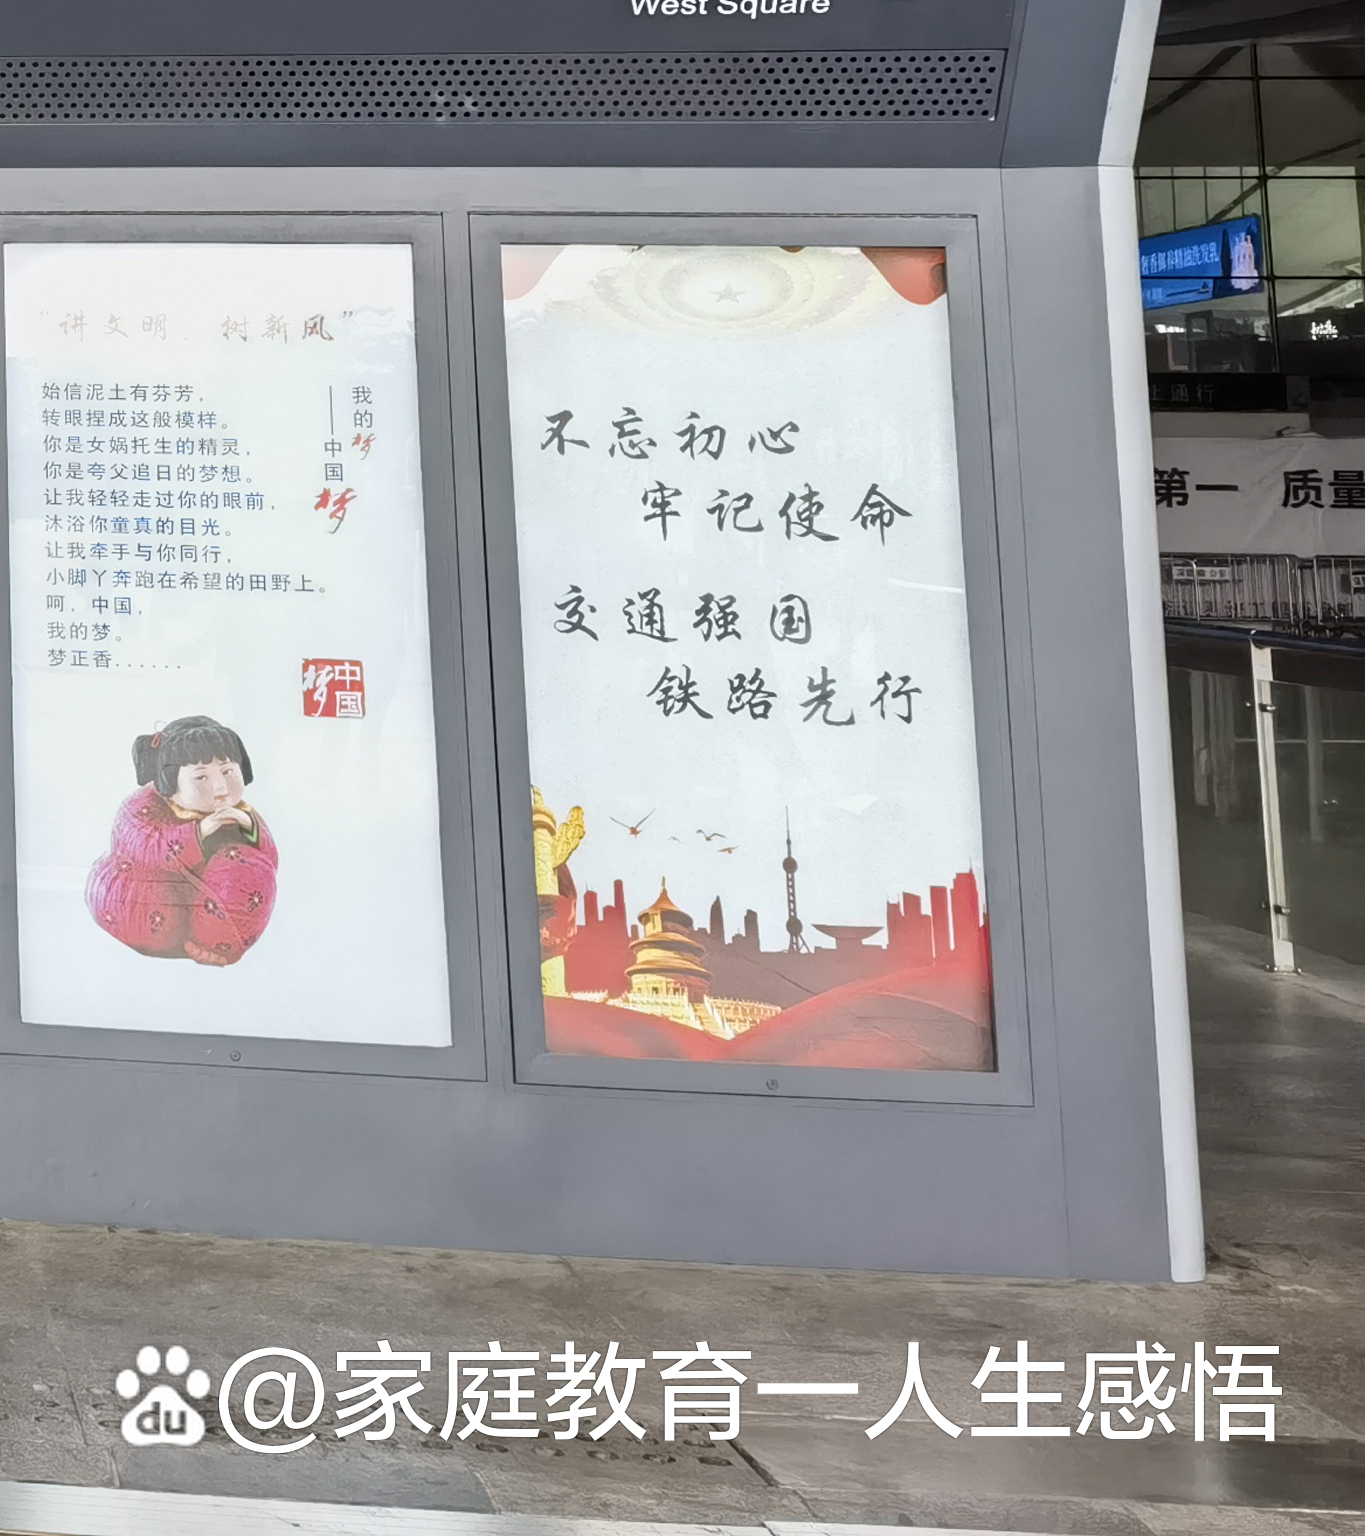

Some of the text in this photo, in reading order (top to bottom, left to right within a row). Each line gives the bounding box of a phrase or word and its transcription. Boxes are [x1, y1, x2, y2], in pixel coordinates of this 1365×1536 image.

[540, 407, 800, 461] 不忘初心
[641, 481, 914, 545] 牢记使命
[1154, 467, 1365, 509] 第一 质量
[553, 585, 812, 645] 交通强国
[646, 664, 923, 726] 铁路先行
